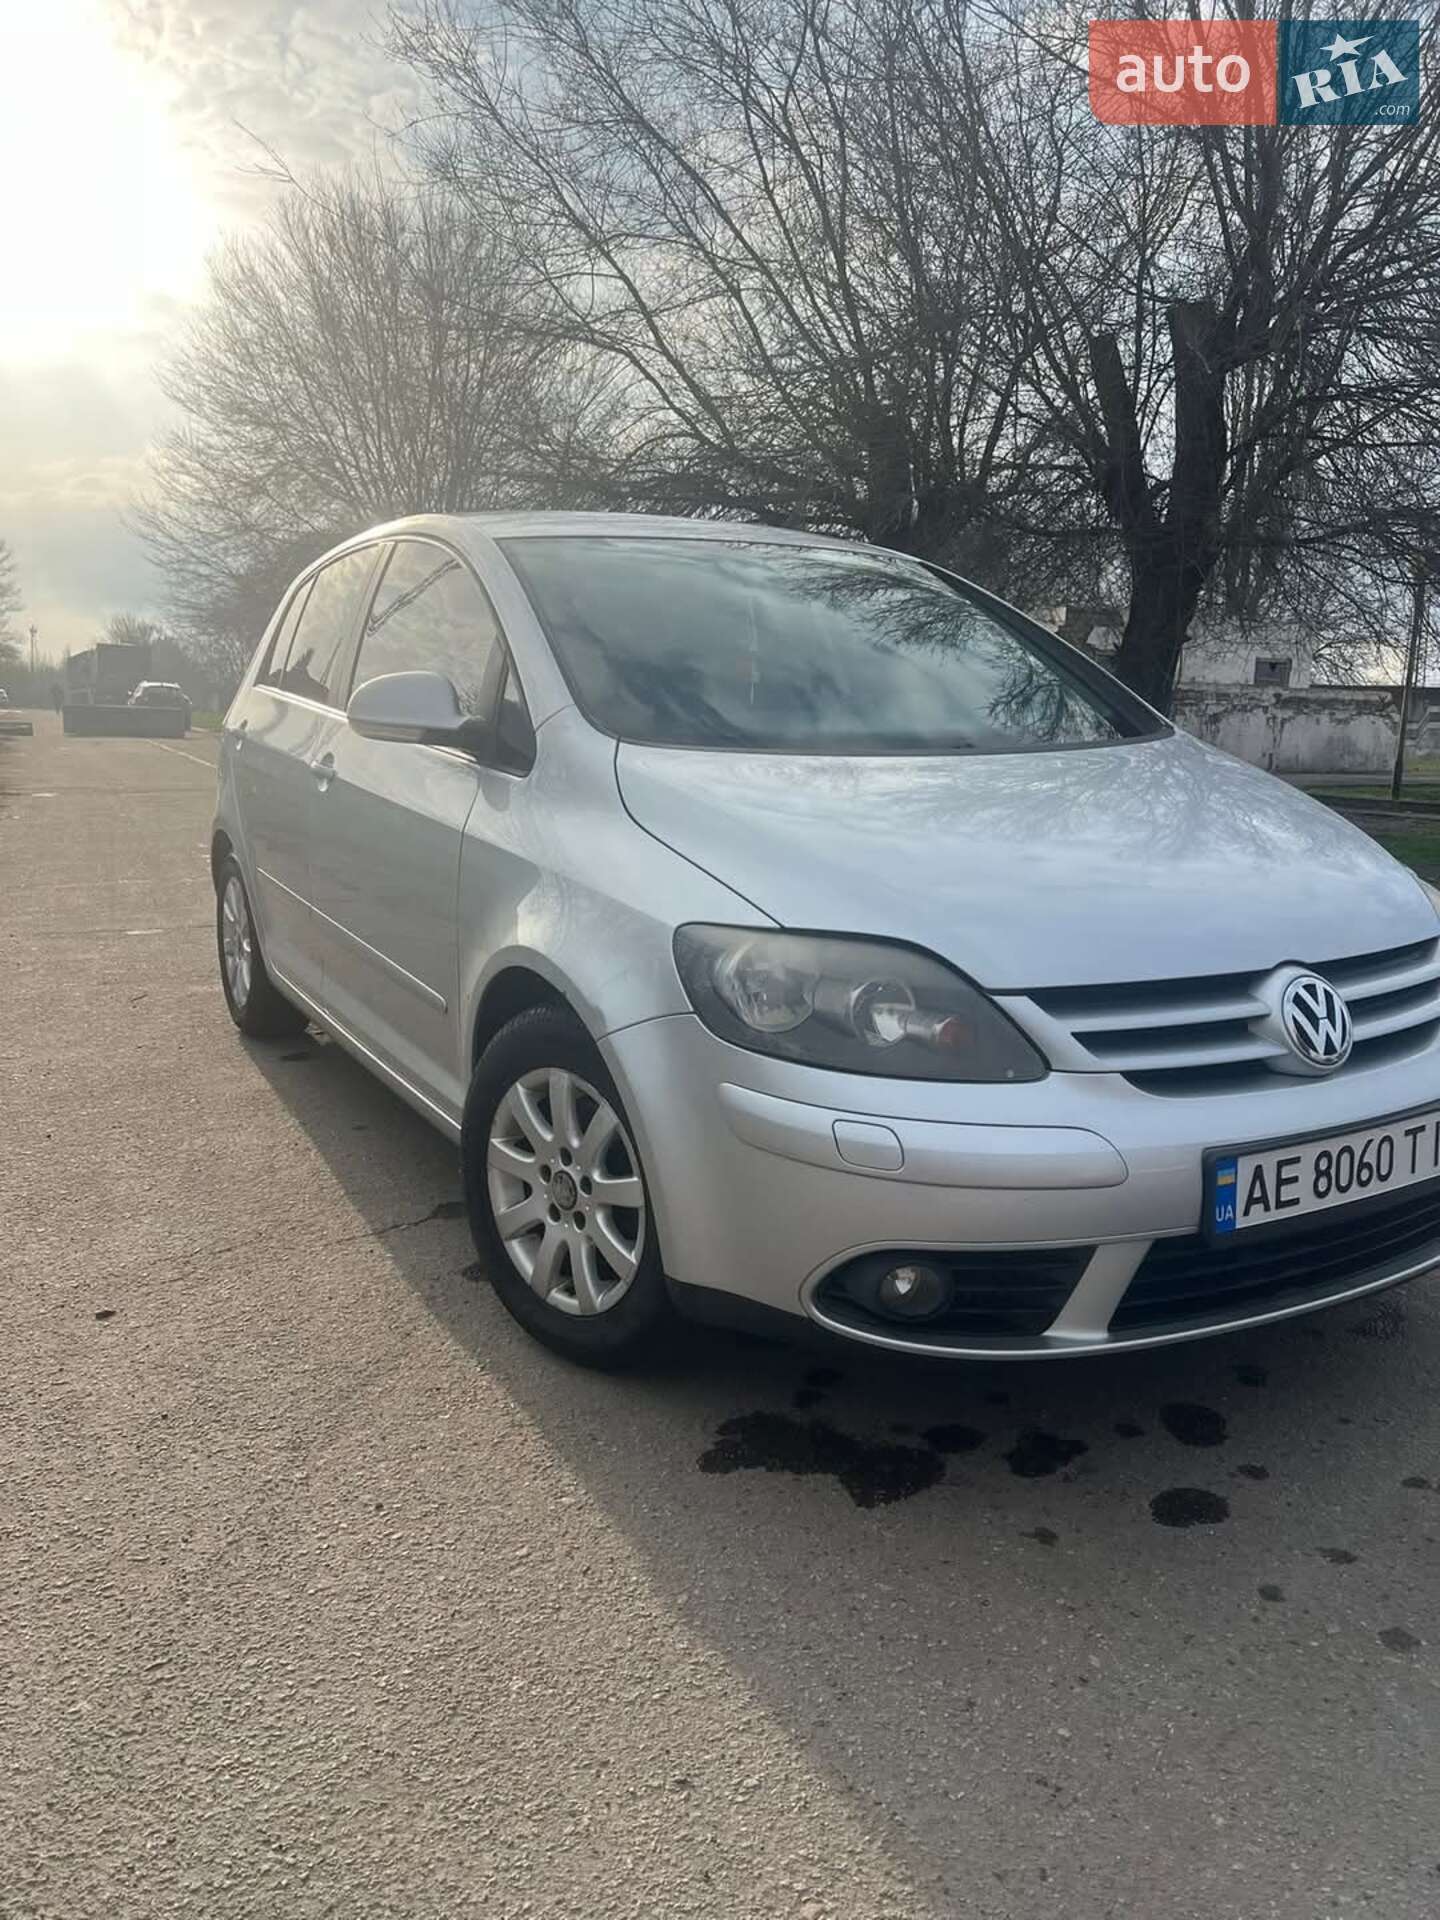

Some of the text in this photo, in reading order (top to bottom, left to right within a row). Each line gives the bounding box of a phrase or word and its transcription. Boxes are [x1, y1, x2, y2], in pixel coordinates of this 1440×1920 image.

[1243, 1156, 1301, 1217] AE
[1313, 1134, 1394, 1199] 8060
[1215, 1204, 1234, 1222] UA
